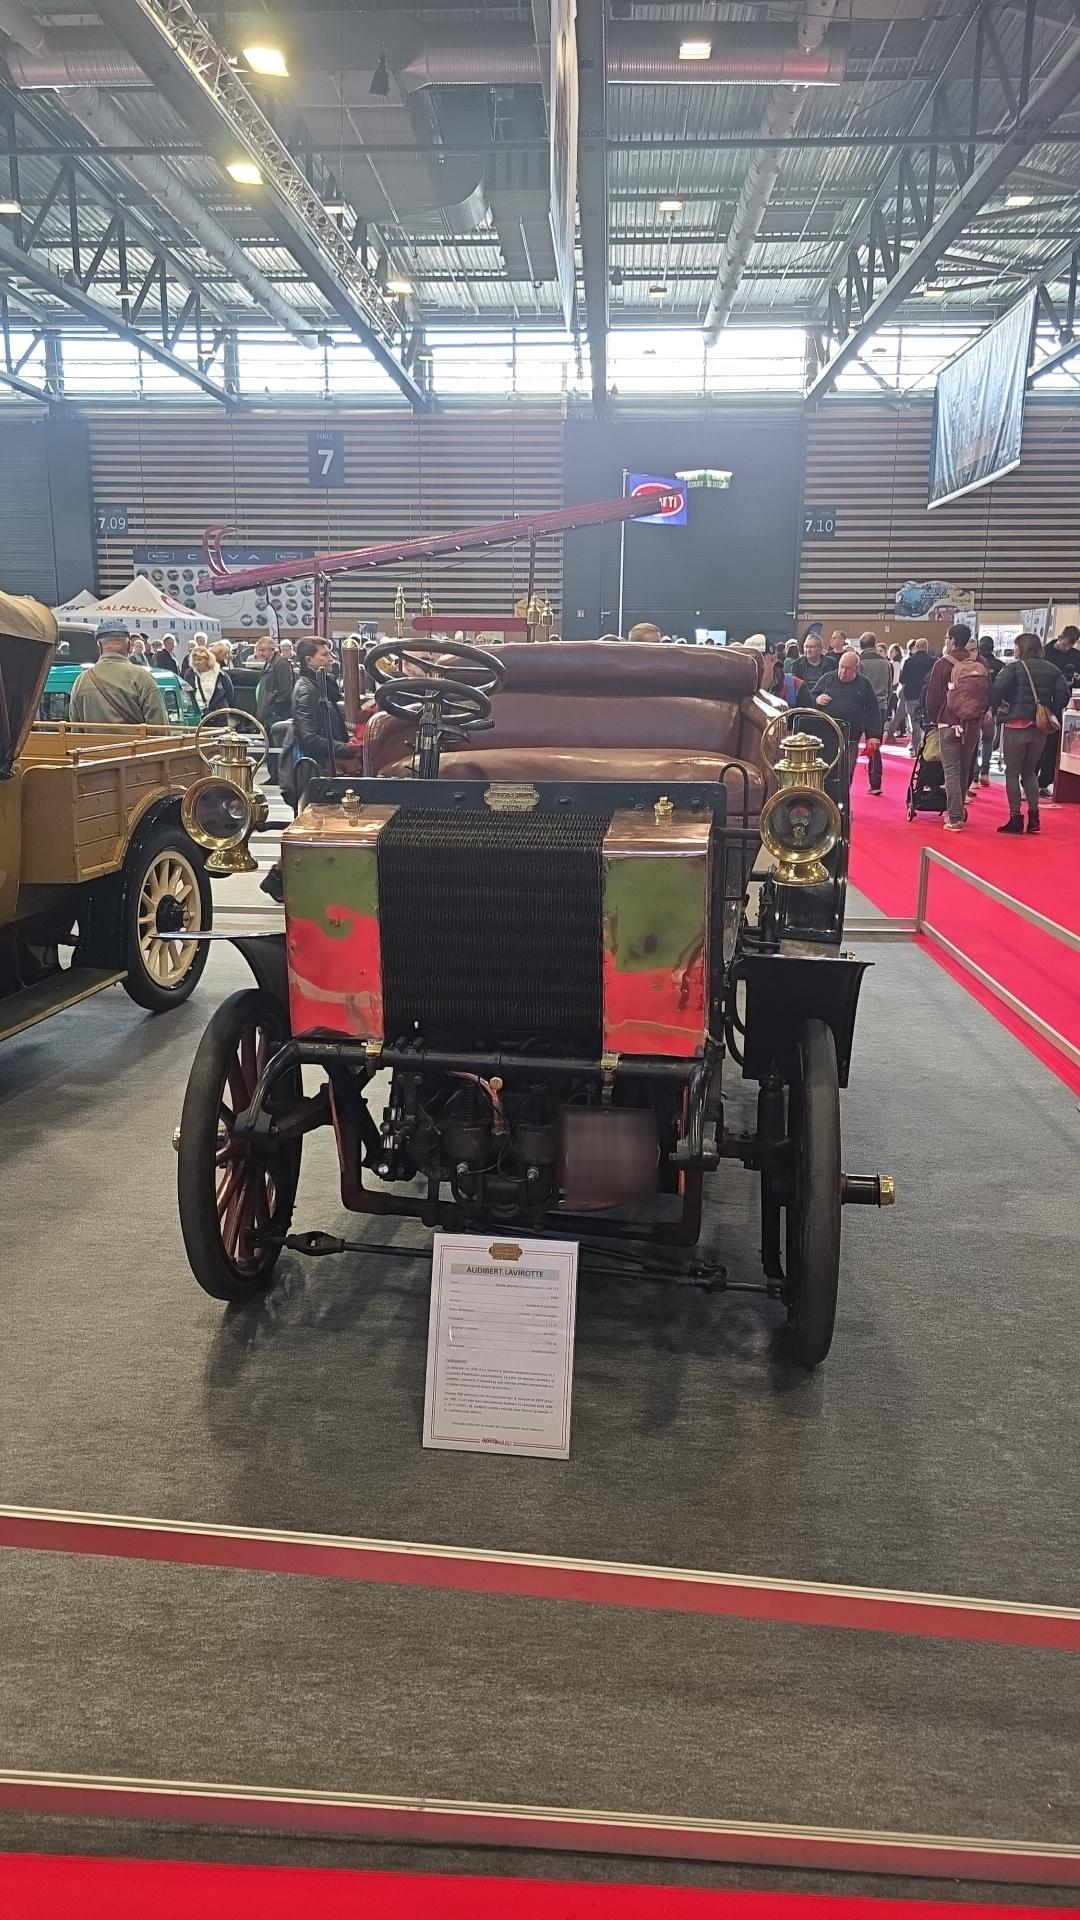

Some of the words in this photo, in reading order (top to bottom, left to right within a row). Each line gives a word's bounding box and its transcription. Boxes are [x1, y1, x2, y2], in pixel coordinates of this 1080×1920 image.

[317, 449, 334, 475] 7
[97, 517, 126, 530] 7.09
[804, 519, 834, 533] 7.10
[95, 604, 158, 614] SALMSON
[466, 1266, 502, 1275] AUDIBERT
[505, 1269, 544, 1278] LAVIROTTE
